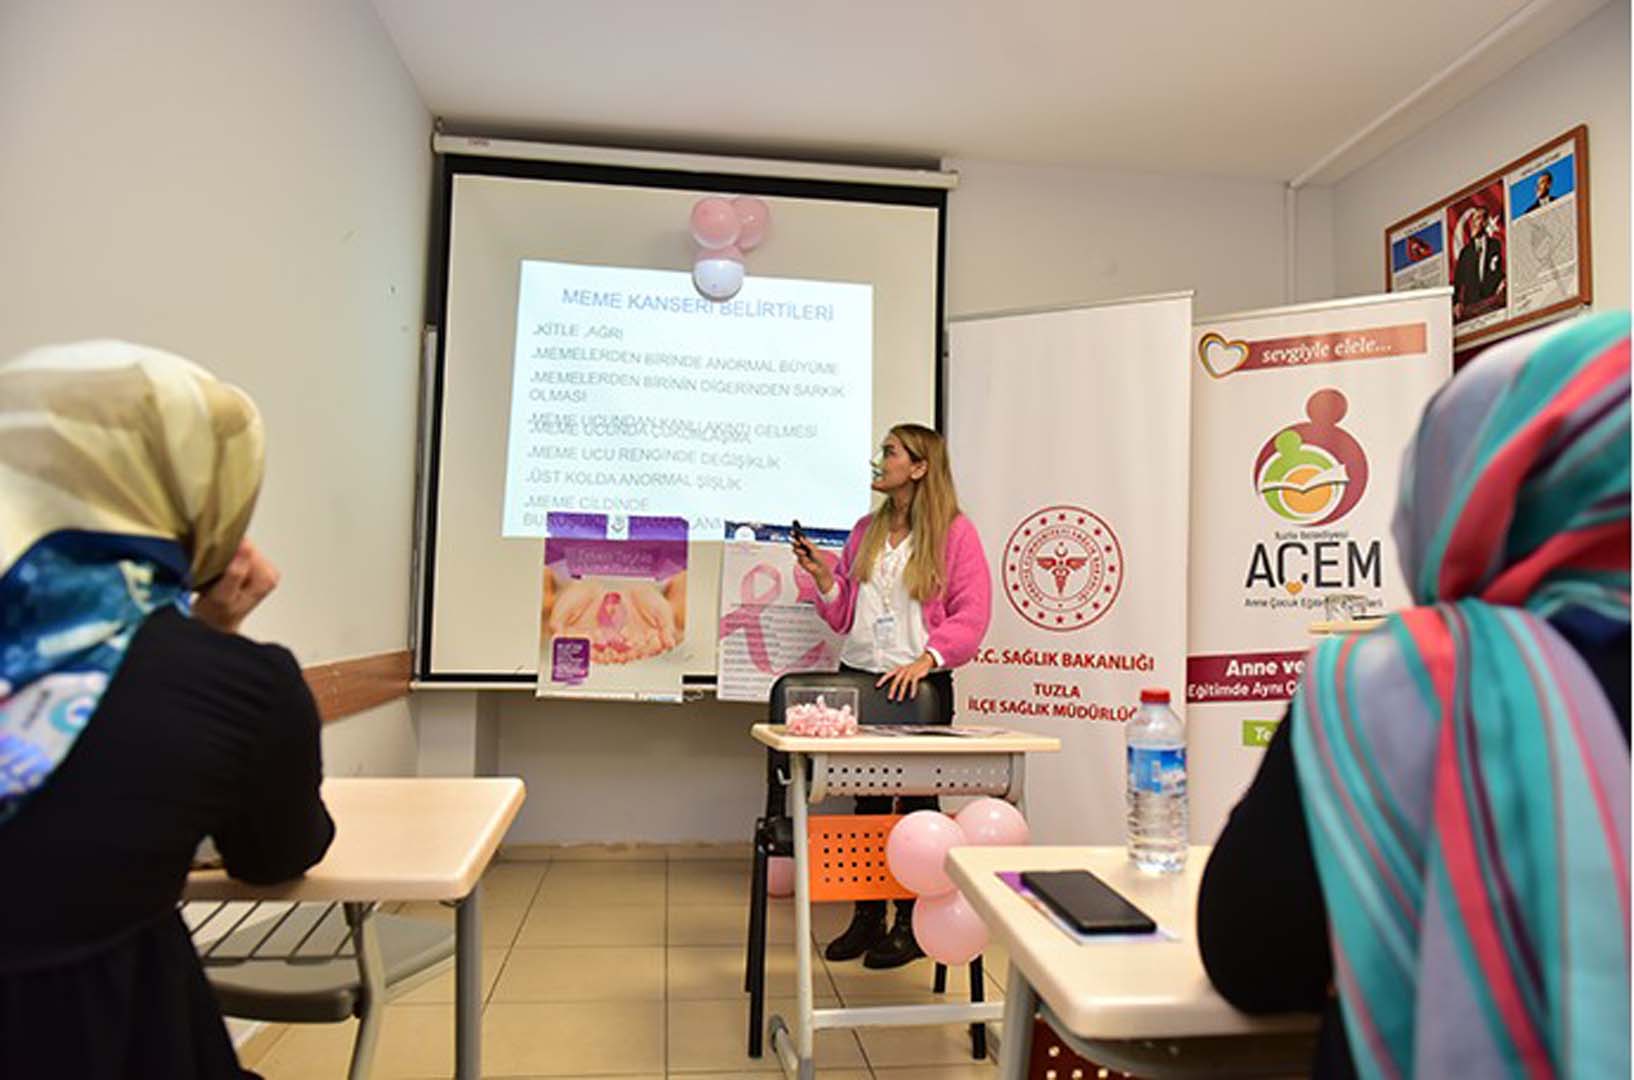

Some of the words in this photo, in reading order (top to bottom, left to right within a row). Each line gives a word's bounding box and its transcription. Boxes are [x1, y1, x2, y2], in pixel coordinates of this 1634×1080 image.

[561, 288, 624, 310] MEME
[1261, 341, 1330, 365] sevgiyle
[580, 447, 616, 462] UCU
[1001, 647, 1059, 667] SAĞLIK
[1061, 652, 1155, 672] BAKANLIĞI
[1226, 659, 1278, 677] Anne
[1033, 683, 1081, 699] TUZLA
[1187, 682, 1250, 700] Eğitimde
[967, 696, 997, 715] İLÇE
[999, 699, 1050, 717] SAĞLIK
